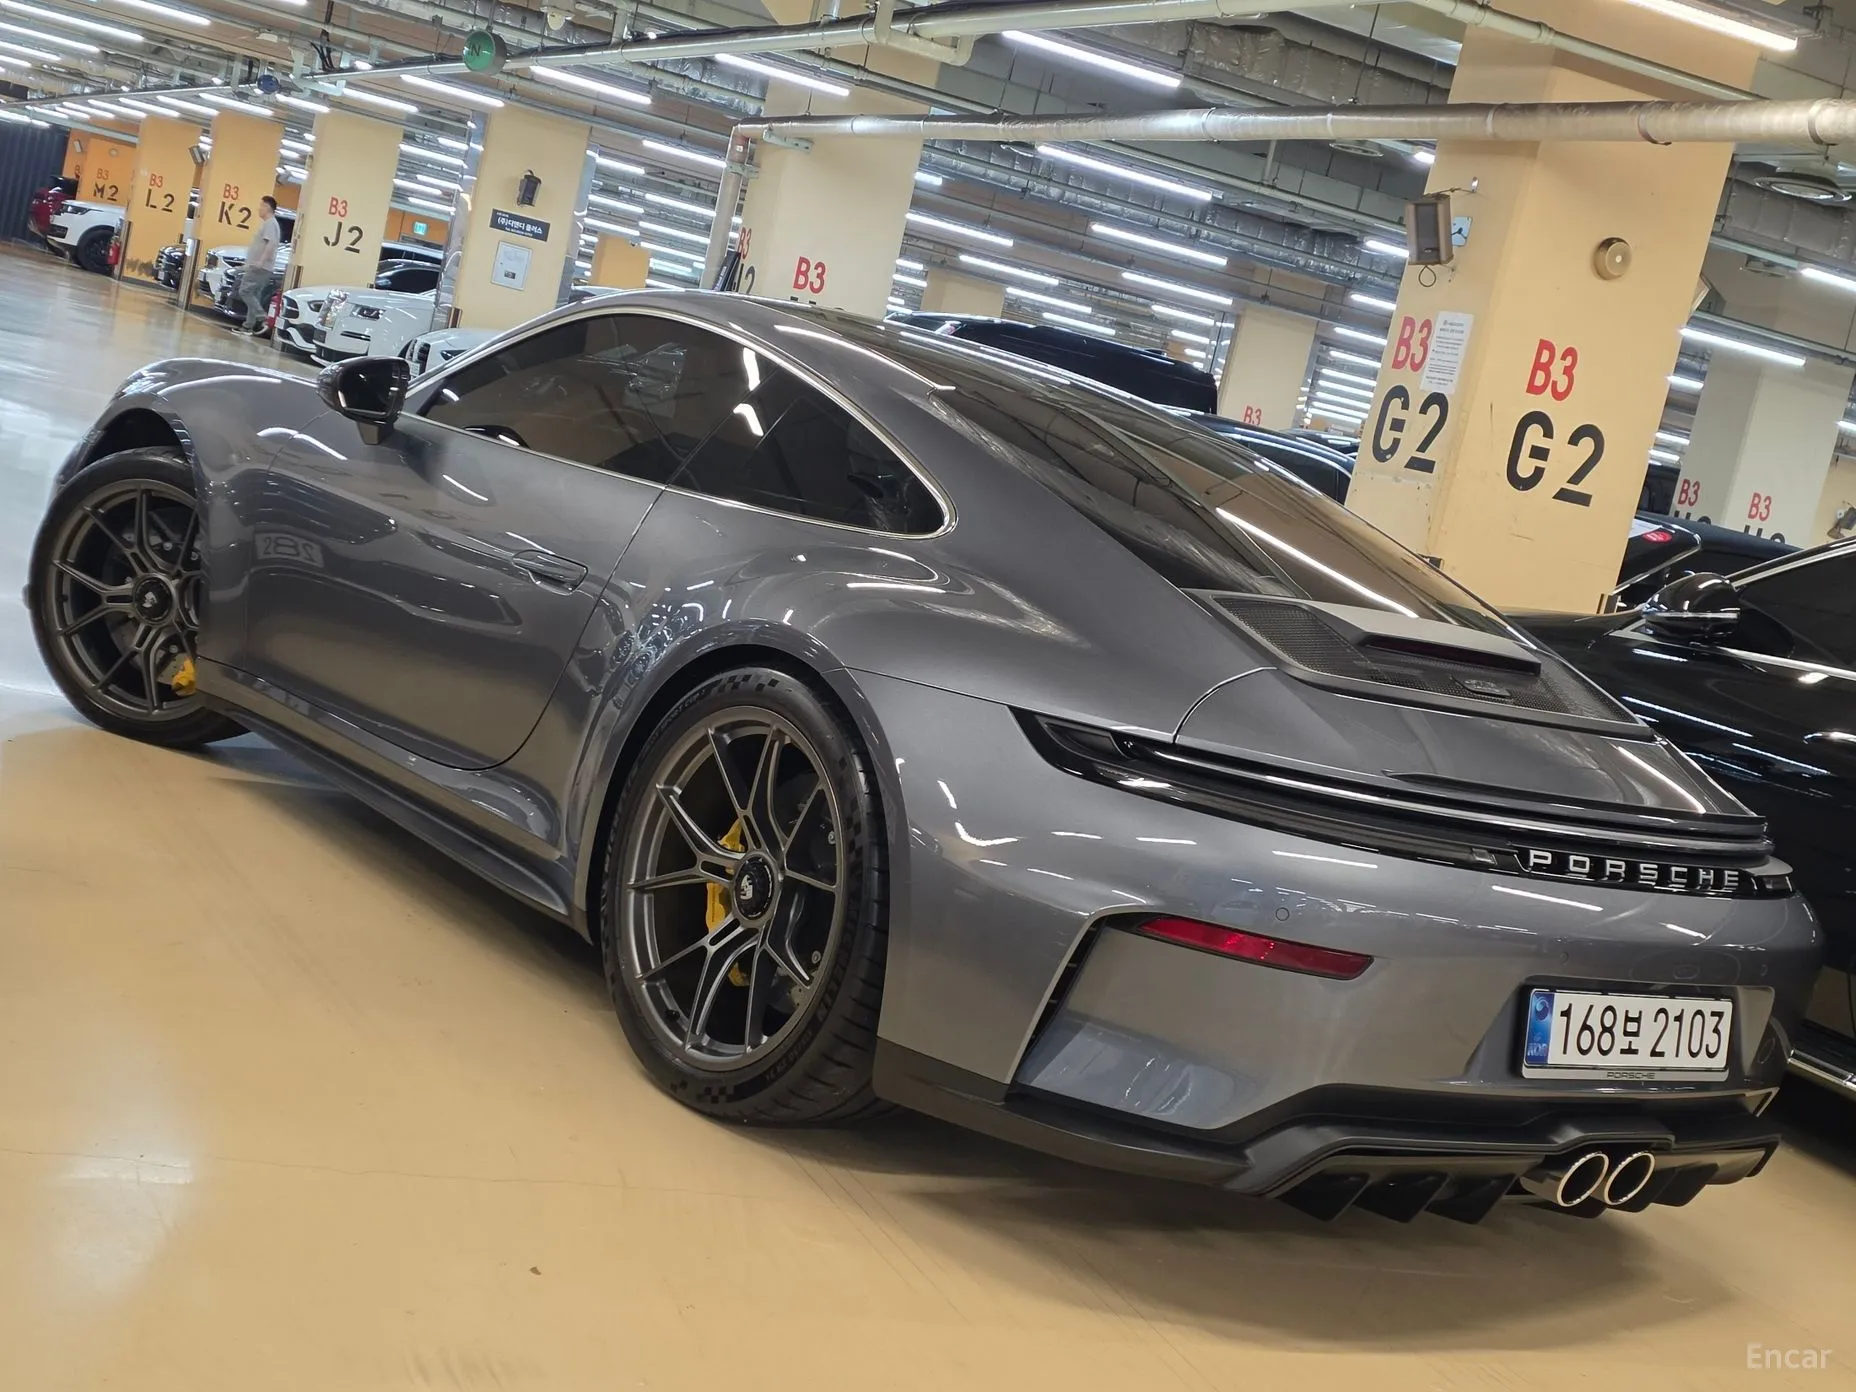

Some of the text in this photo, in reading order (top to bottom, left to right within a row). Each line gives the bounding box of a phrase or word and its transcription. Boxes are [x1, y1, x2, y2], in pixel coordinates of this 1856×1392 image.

[97, 168, 109, 180] B3
[149, 173, 164, 188] B3
[93, 182, 119, 201] M2
[145, 188, 175, 213] L2
[223, 183, 239, 200] B3
[218, 201, 252, 229] K2
[328, 196, 348, 217] B3
[323, 221, 364, 254] J2
[738, 227, 752, 260] B3
[793, 256, 826, 294] B3
[1392, 316, 1432, 372] B3
[1526, 338, 1578, 401] B3
[1244, 405, 1262, 426] B3
[1372, 384, 1449, 474] G2
[1506, 410, 1605, 507] G2
[1678, 479, 1700, 507] B3
[1748, 492, 1772, 521] B3
[1529, 850, 1739, 888] PORSCHE
[1607, 1071, 1655, 1079] PORSCHE
